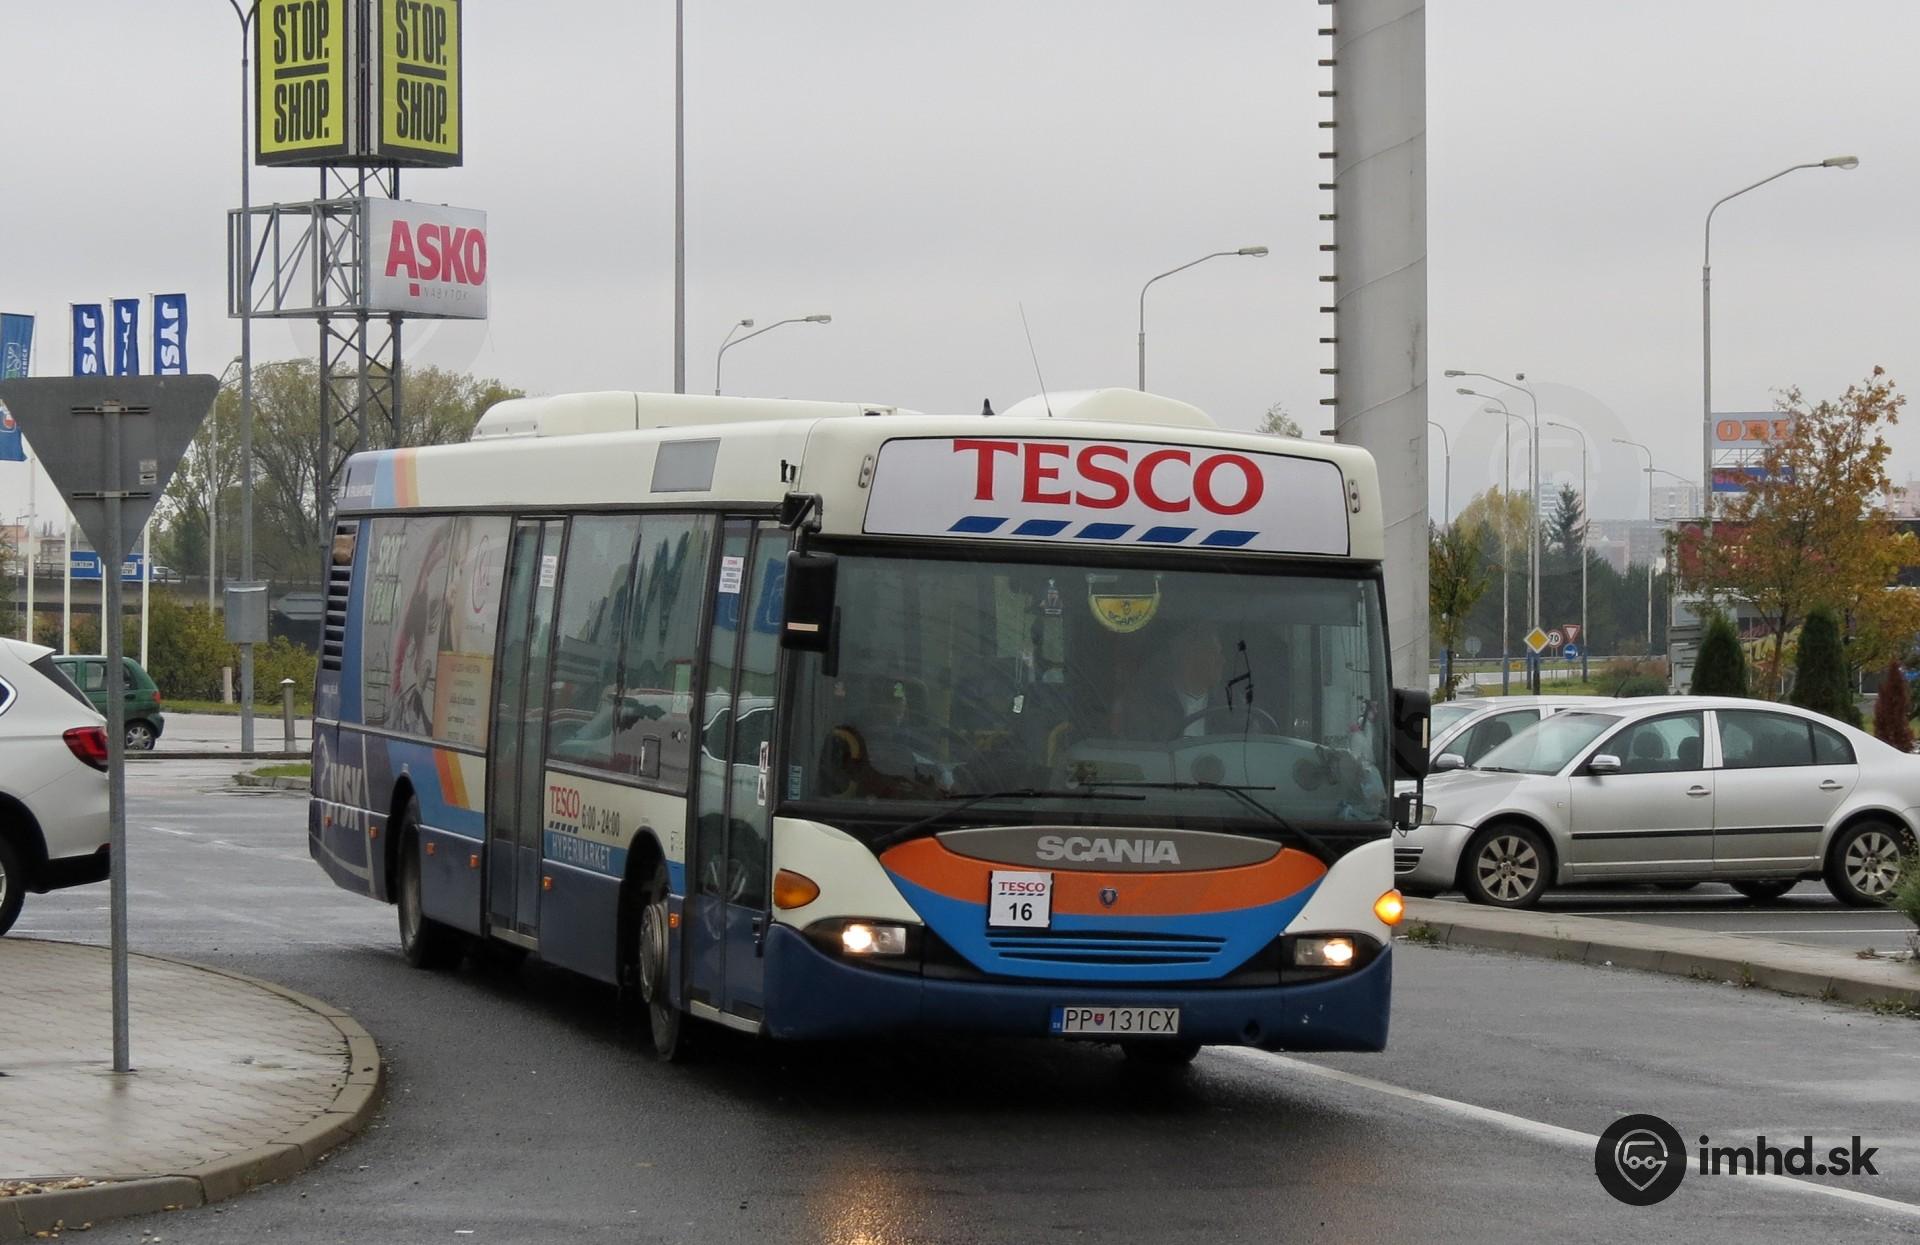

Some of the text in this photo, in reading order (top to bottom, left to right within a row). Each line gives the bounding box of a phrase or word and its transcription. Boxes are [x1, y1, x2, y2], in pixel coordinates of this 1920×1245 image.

[274, 79, 329, 143] SHOP.
[397, 78, 447, 144] SHOP.
[385, 220, 487, 286] ASKO
[1716, 420, 1791, 441] OBI
[953, 438, 1264, 516] TESCO
[550, 786, 580, 819] TESCO
[552, 833, 610, 870] HYPERMARKET
[1036, 836, 1180, 864] SCANIA
[999, 882, 1045, 893] TESCO
[1009, 902, 1032, 921] 16
